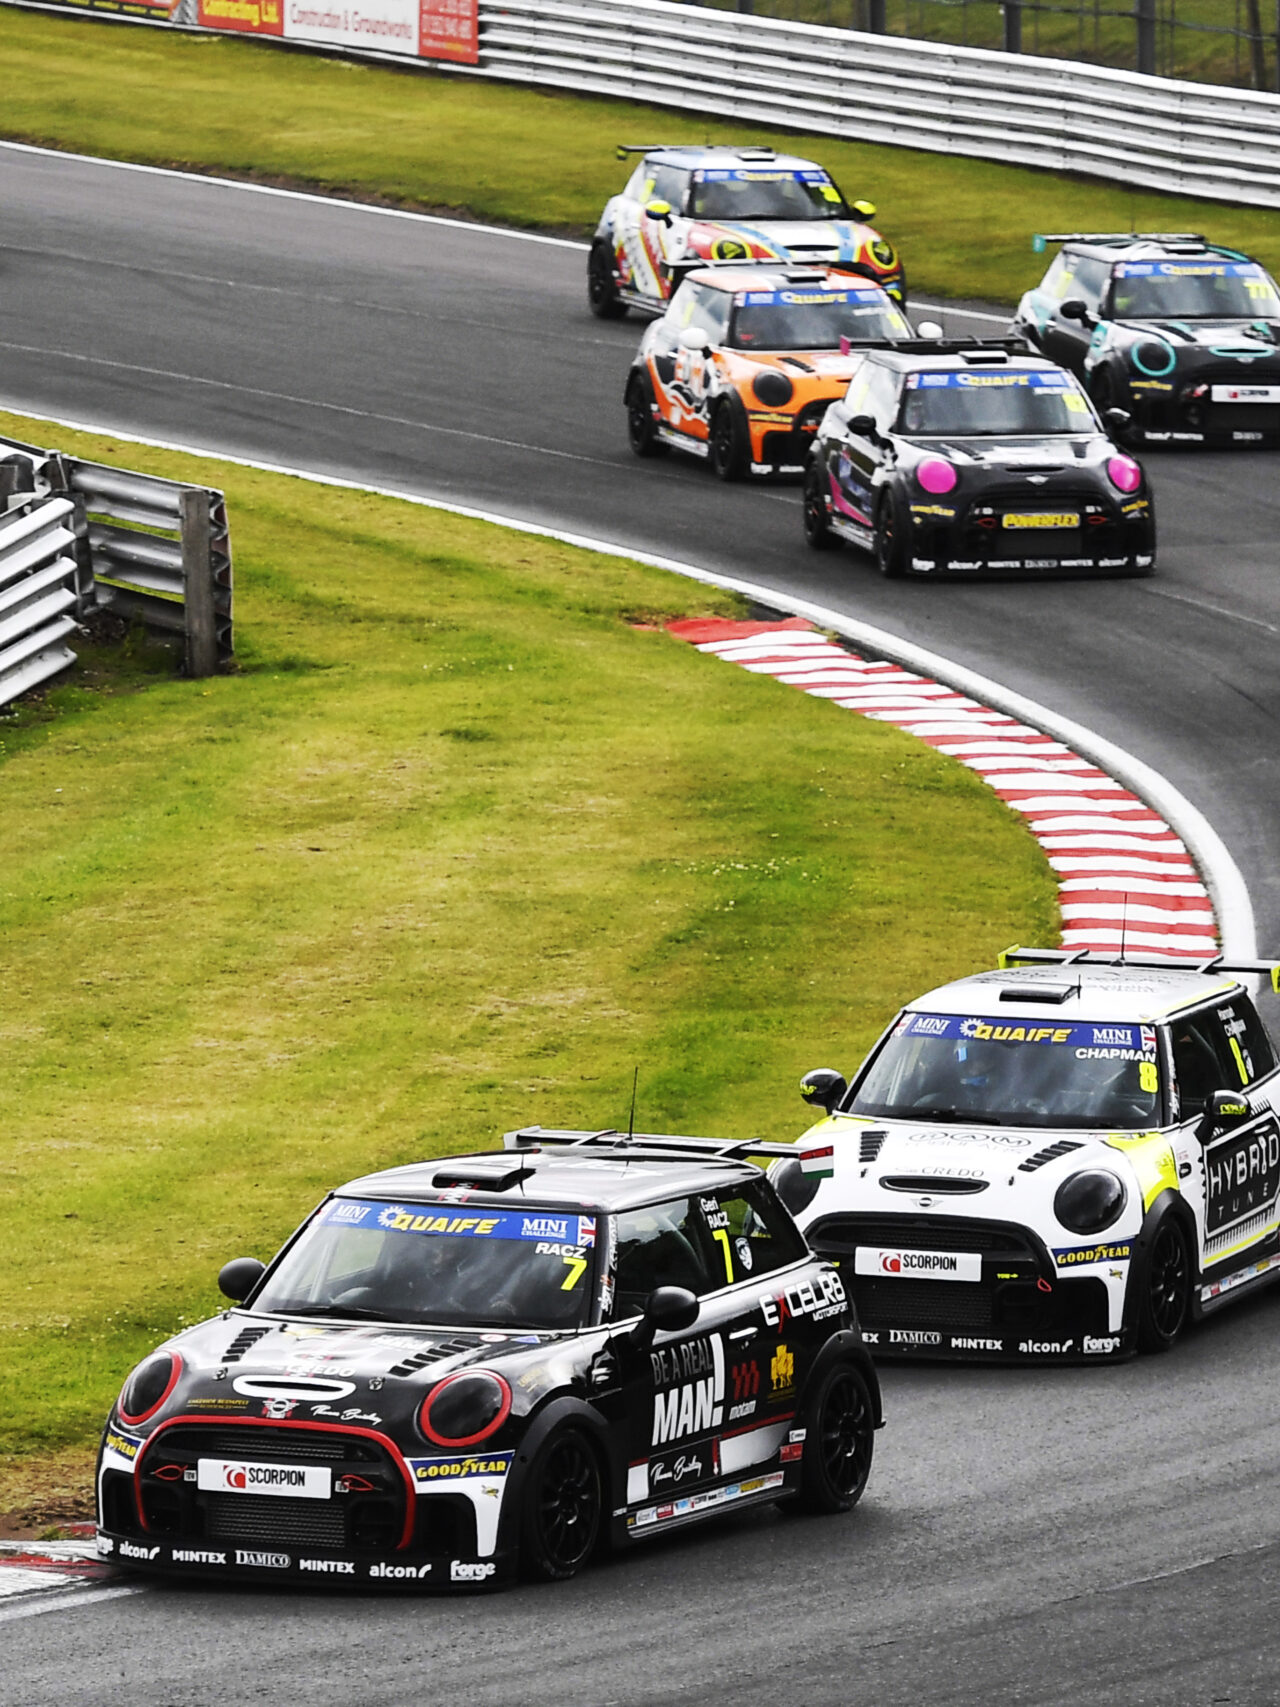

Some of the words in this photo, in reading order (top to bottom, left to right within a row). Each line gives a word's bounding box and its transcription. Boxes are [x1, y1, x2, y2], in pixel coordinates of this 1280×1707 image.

[915, 1017, 951, 1033] MINI
[972, 1024, 1073, 1043] QUAIFE
[1092, 1028, 1132, 1041] MINI
[1074, 1047, 1156, 1063] CHAPMAN
[1138, 1061, 1159, 1094] 8
[921, 1166, 985, 1178] CREDO
[334, 1204, 372, 1220] MINI
[391, 1213, 501, 1235] QUAIFE
[521, 1218, 569, 1234] MINI
[706, 1211, 731, 1230] RACZ
[521, 1230, 567, 1240] CHALLENGE
[534, 1242, 588, 1259] RACZ
[712, 1228, 734, 1284] 7
[903, 1253, 957, 1272] SCORPION
[1056, 1245, 1131, 1264] GOODYEAR
[560, 1257, 588, 1292] 7
[758, 1270, 846, 1334] EXCELR8
[888, 1329, 943, 1345] DAMICO
[951, 1337, 1003, 1351] MINTEX
[1019, 1340, 1061, 1353] alcon
[1083, 1335, 1121, 1354] forge
[650, 1350, 670, 1386] BE
[672, 1347, 682, 1377] A
[681, 1337, 714, 1375] REAL
[651, 1332, 726, 1447] MAN!
[248, 1467, 306, 1487] SCORPION
[416, 1457, 507, 1478] GOODYEAR
[119, 1541, 149, 1559] alcon
[172, 1550, 227, 1565] MINTEX
[235, 1550, 291, 1568] DAMICO
[299, 1559, 356, 1575] MINTEX
[369, 1563, 417, 1579] alcon
[450, 1560, 496, 1582] forge
